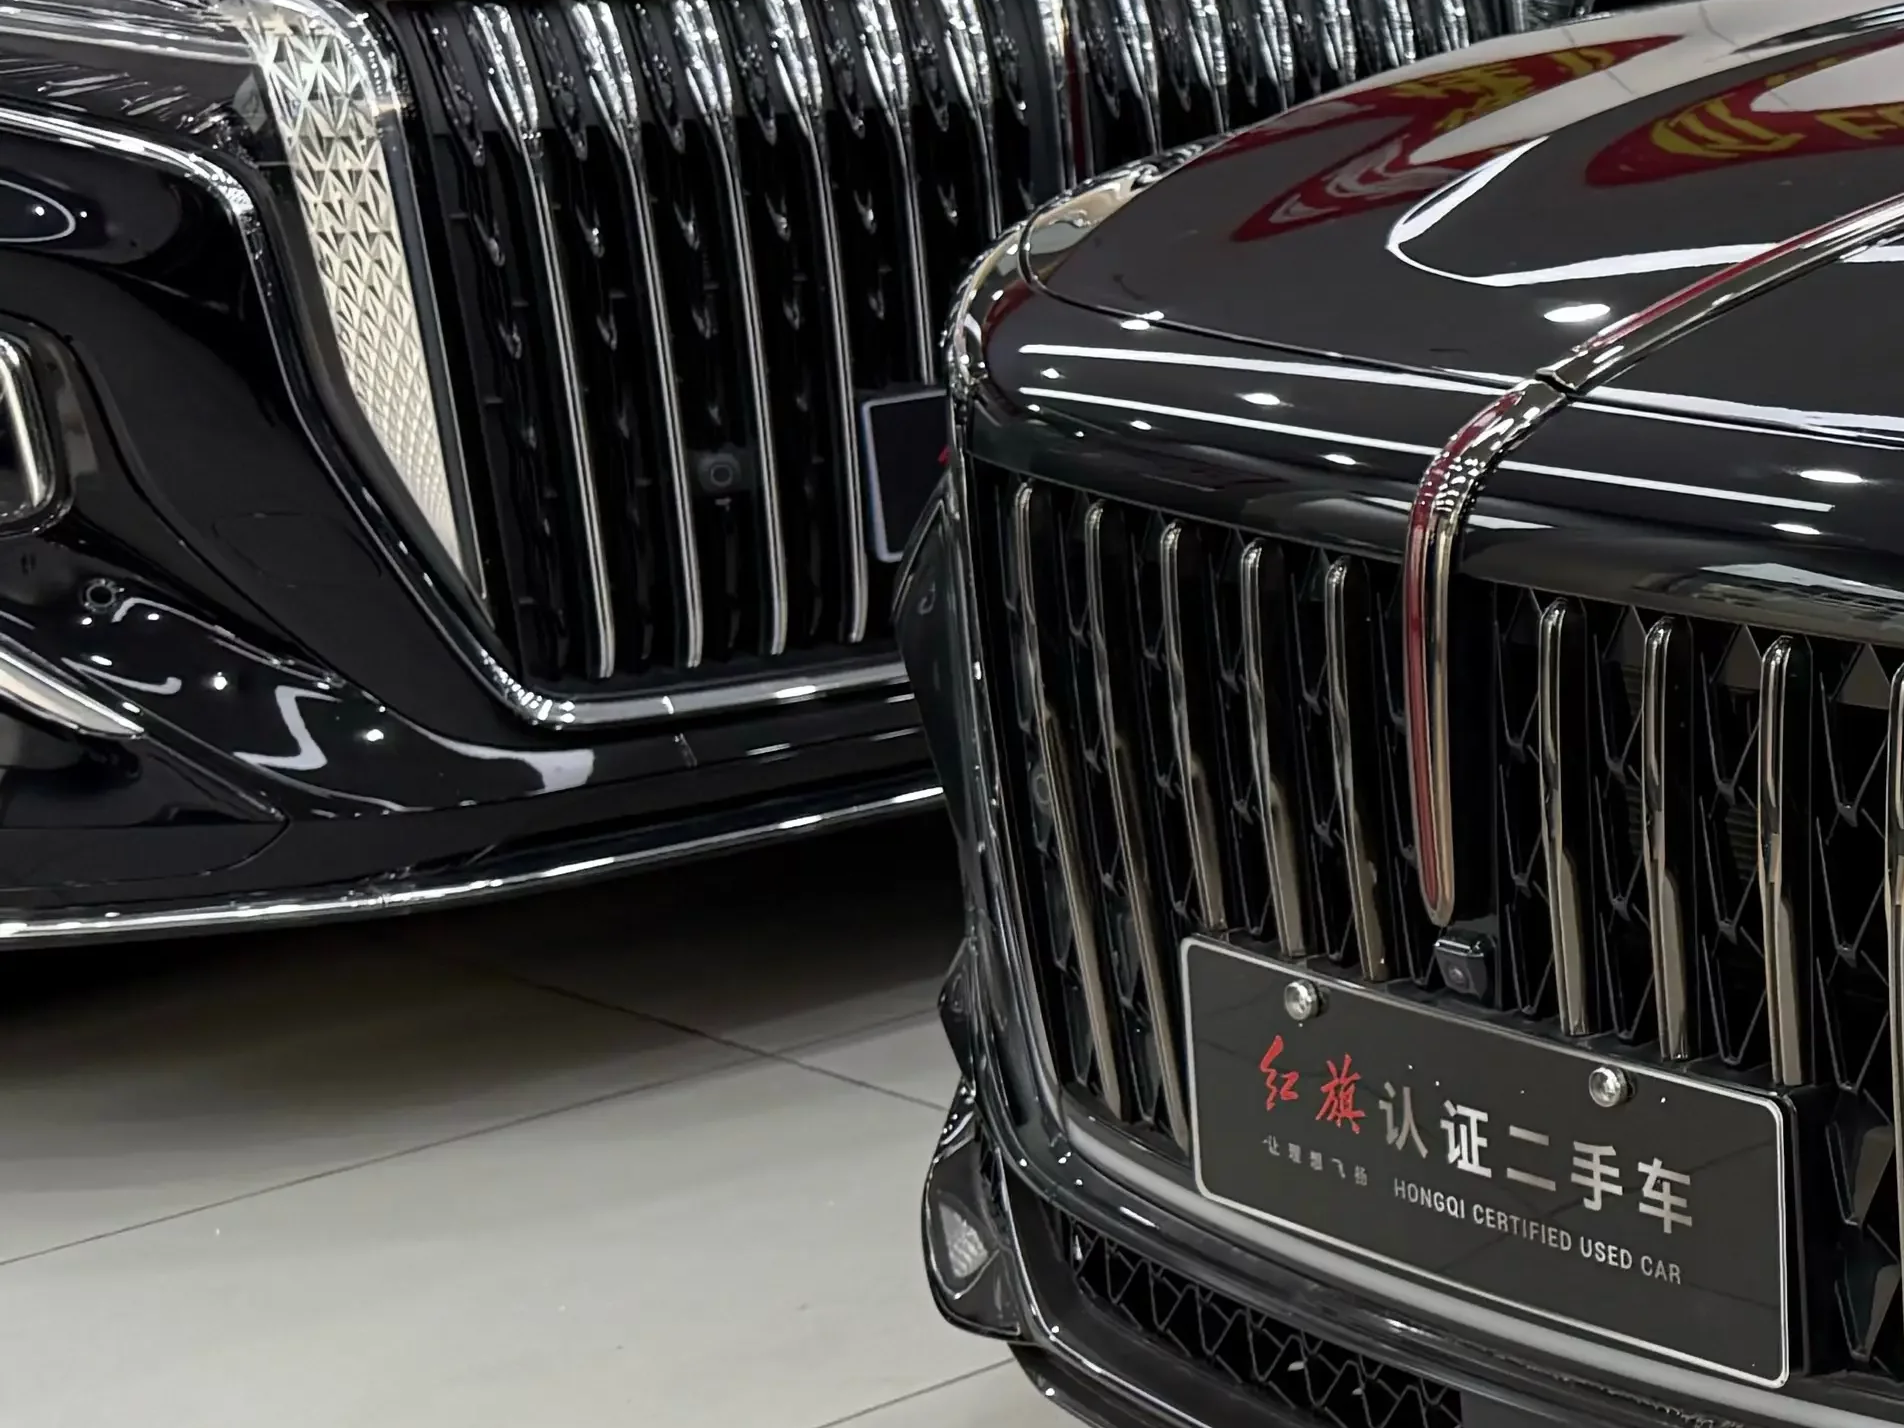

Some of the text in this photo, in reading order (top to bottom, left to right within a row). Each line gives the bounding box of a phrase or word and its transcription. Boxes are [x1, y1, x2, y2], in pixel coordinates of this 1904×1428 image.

[1393, 1178, 1682, 1285] HONGQI CERTIFIED USED CAR
